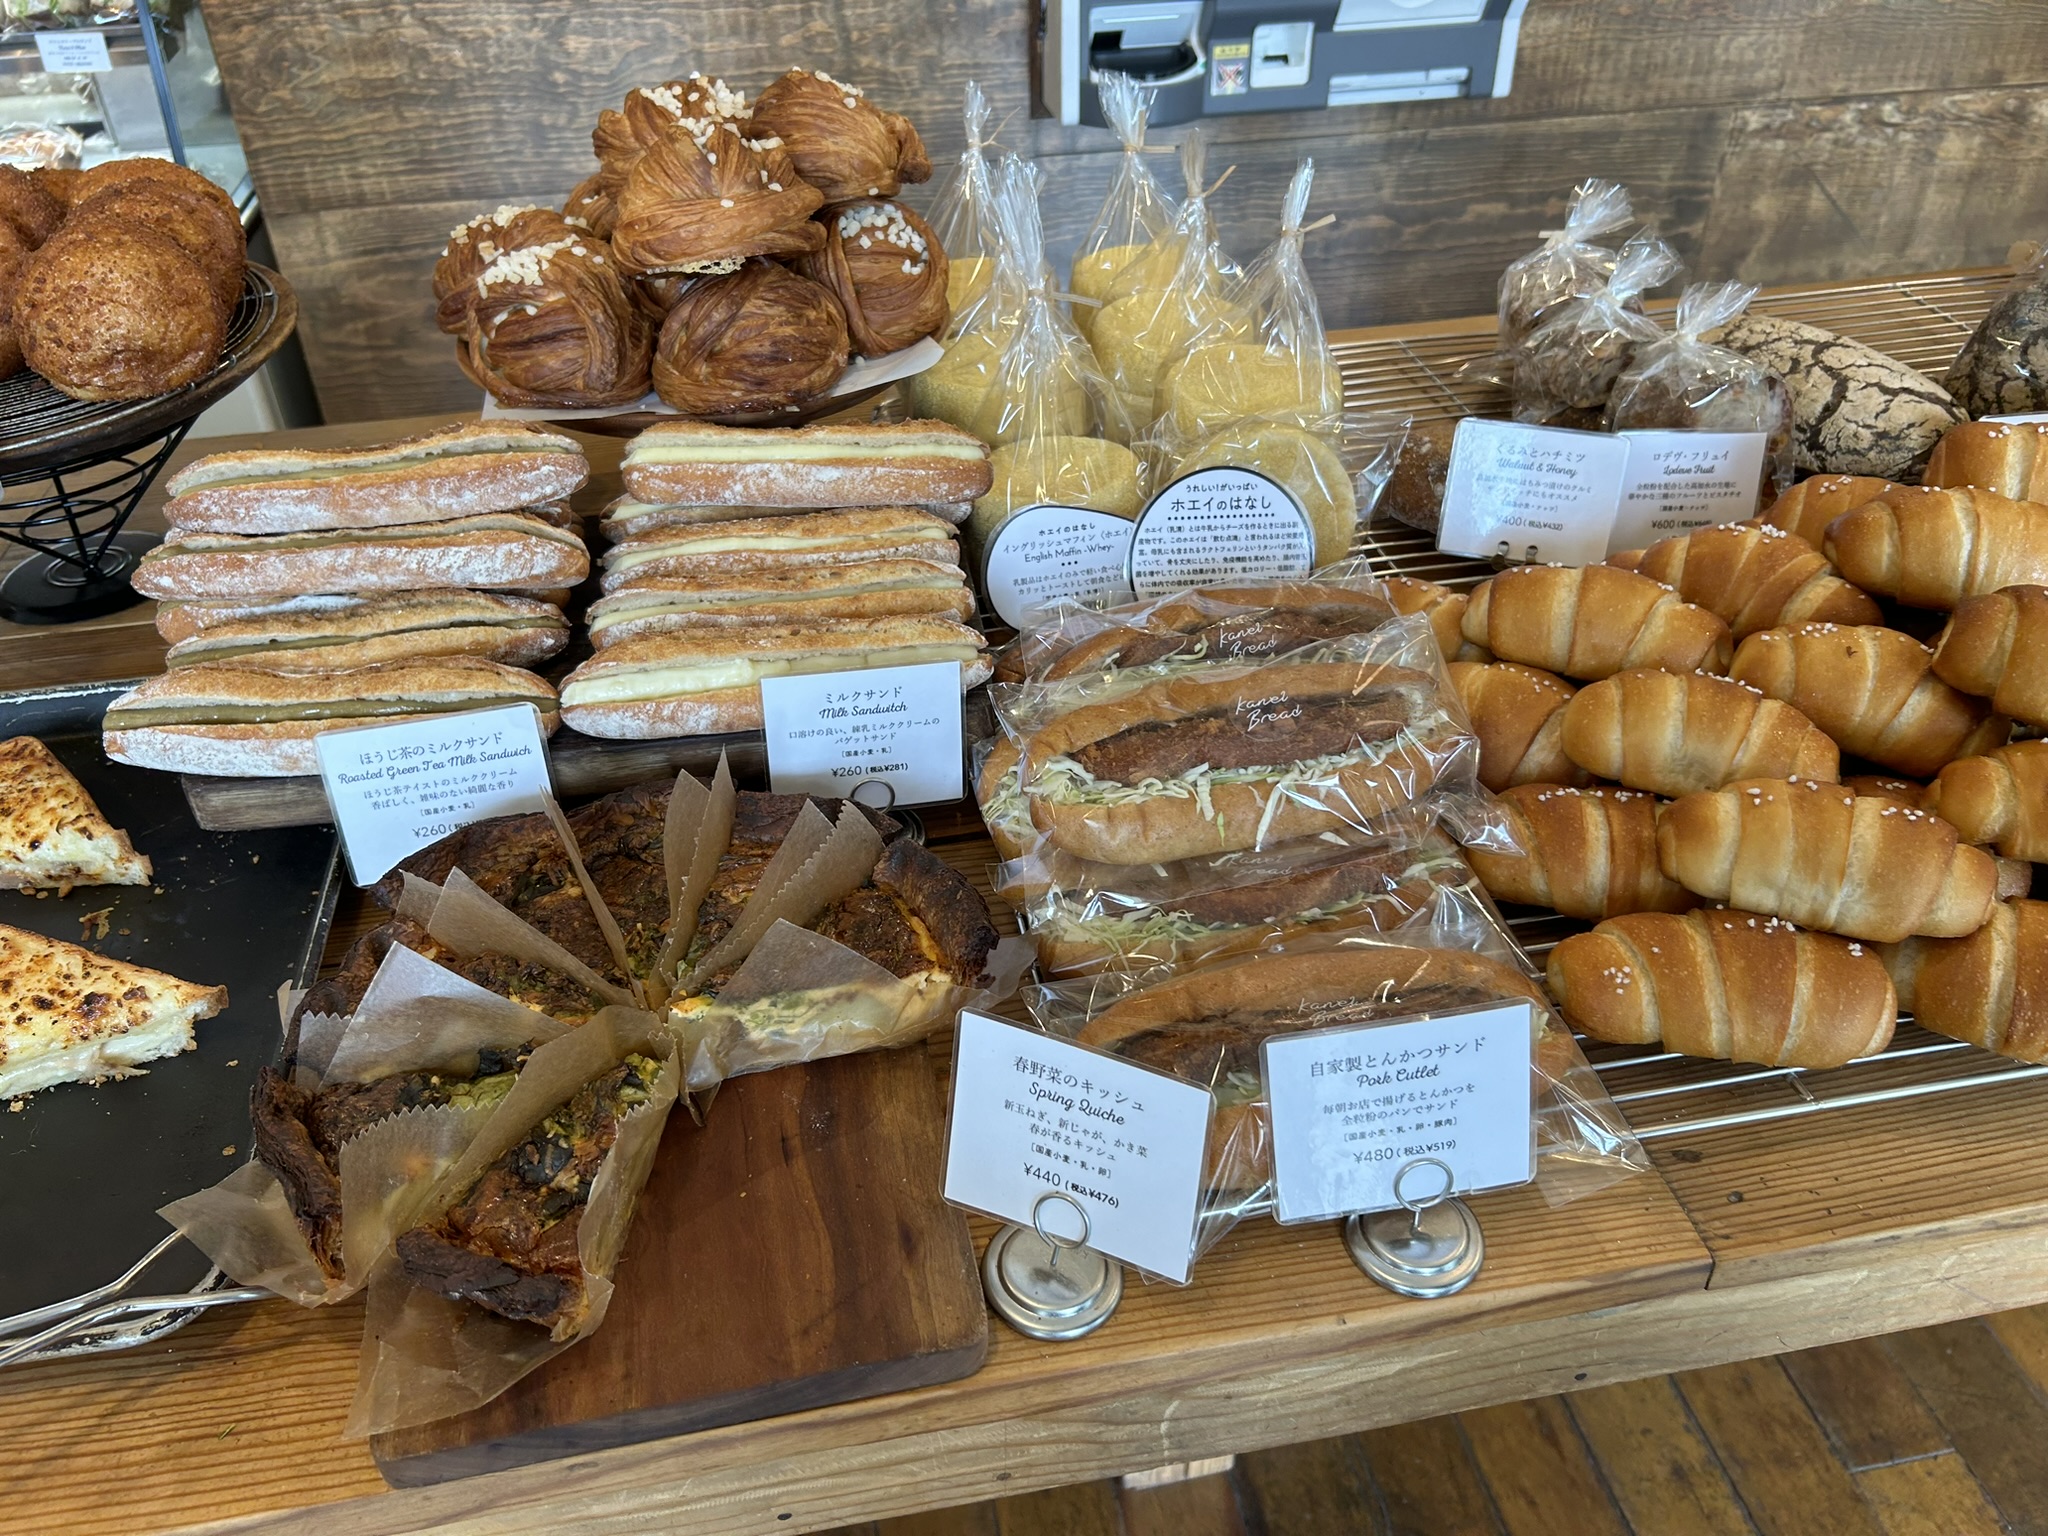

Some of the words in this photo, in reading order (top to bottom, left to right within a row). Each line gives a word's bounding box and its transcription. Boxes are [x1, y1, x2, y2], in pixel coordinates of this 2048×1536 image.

[1536, 463, 1543, 472] &
[1546, 463, 1578, 478] Honey
[1693, 464, 1715, 474] Fruit
[1171, 496, 1271, 512] ホエイのはなし
[1039, 523, 1096, 536] ホエイのはなし
[1652, 520, 1675, 529] ¥600
[1024, 550, 1053, 563] English
[1230, 635, 1278, 660] Bread
[826, 686, 902, 704] ミルクサンド
[819, 707, 849, 719] Milk
[851, 701, 908, 716] Sandwitch
[1247, 704, 1302, 732] Bread
[359, 731, 502, 765] ほうじ茶のミルクサンド
[338, 768, 384, 784] Roasted
[386, 765, 421, 780] Green
[422, 760, 446, 771] Tea
[447, 754, 478, 767] Milk
[480, 745, 533, 762] Sandwich
[831, 766, 862, 778] ¥260
[363, 768, 518, 799] ほうじ茶テイストのミルククリーム
[371, 780, 514, 810] 香ばしく、雑味のない綺麗な香り
[412, 824, 447, 838] ¥260
[1309, 1008, 1375, 1027] Bread
[1310, 1036, 1486, 1077] 自家製とんかつサンド
[1013, 1056, 1145, 1112] 春野菜のキッシュ
[1357, 1072, 1392, 1088] Pork
[1396, 1064, 1440, 1082] Cutlet
[1029, 1081, 1075, 1111] Spring
[1078, 1098, 1125, 1125] Quiche
[1323, 1083, 1475, 1115] 毎朝お店で揚げるとんかつを
[1004, 1099, 1149, 1158] 新玉ねぎ、新じゃが、かき菜
[1030, 1123, 1116, 1161] 春が香るキッシュ
[1353, 1147, 1394, 1164] ¥480
[1024, 1162, 1061, 1186] ¥440
[1065, 1180, 1119, 1208] (税込¥476)
